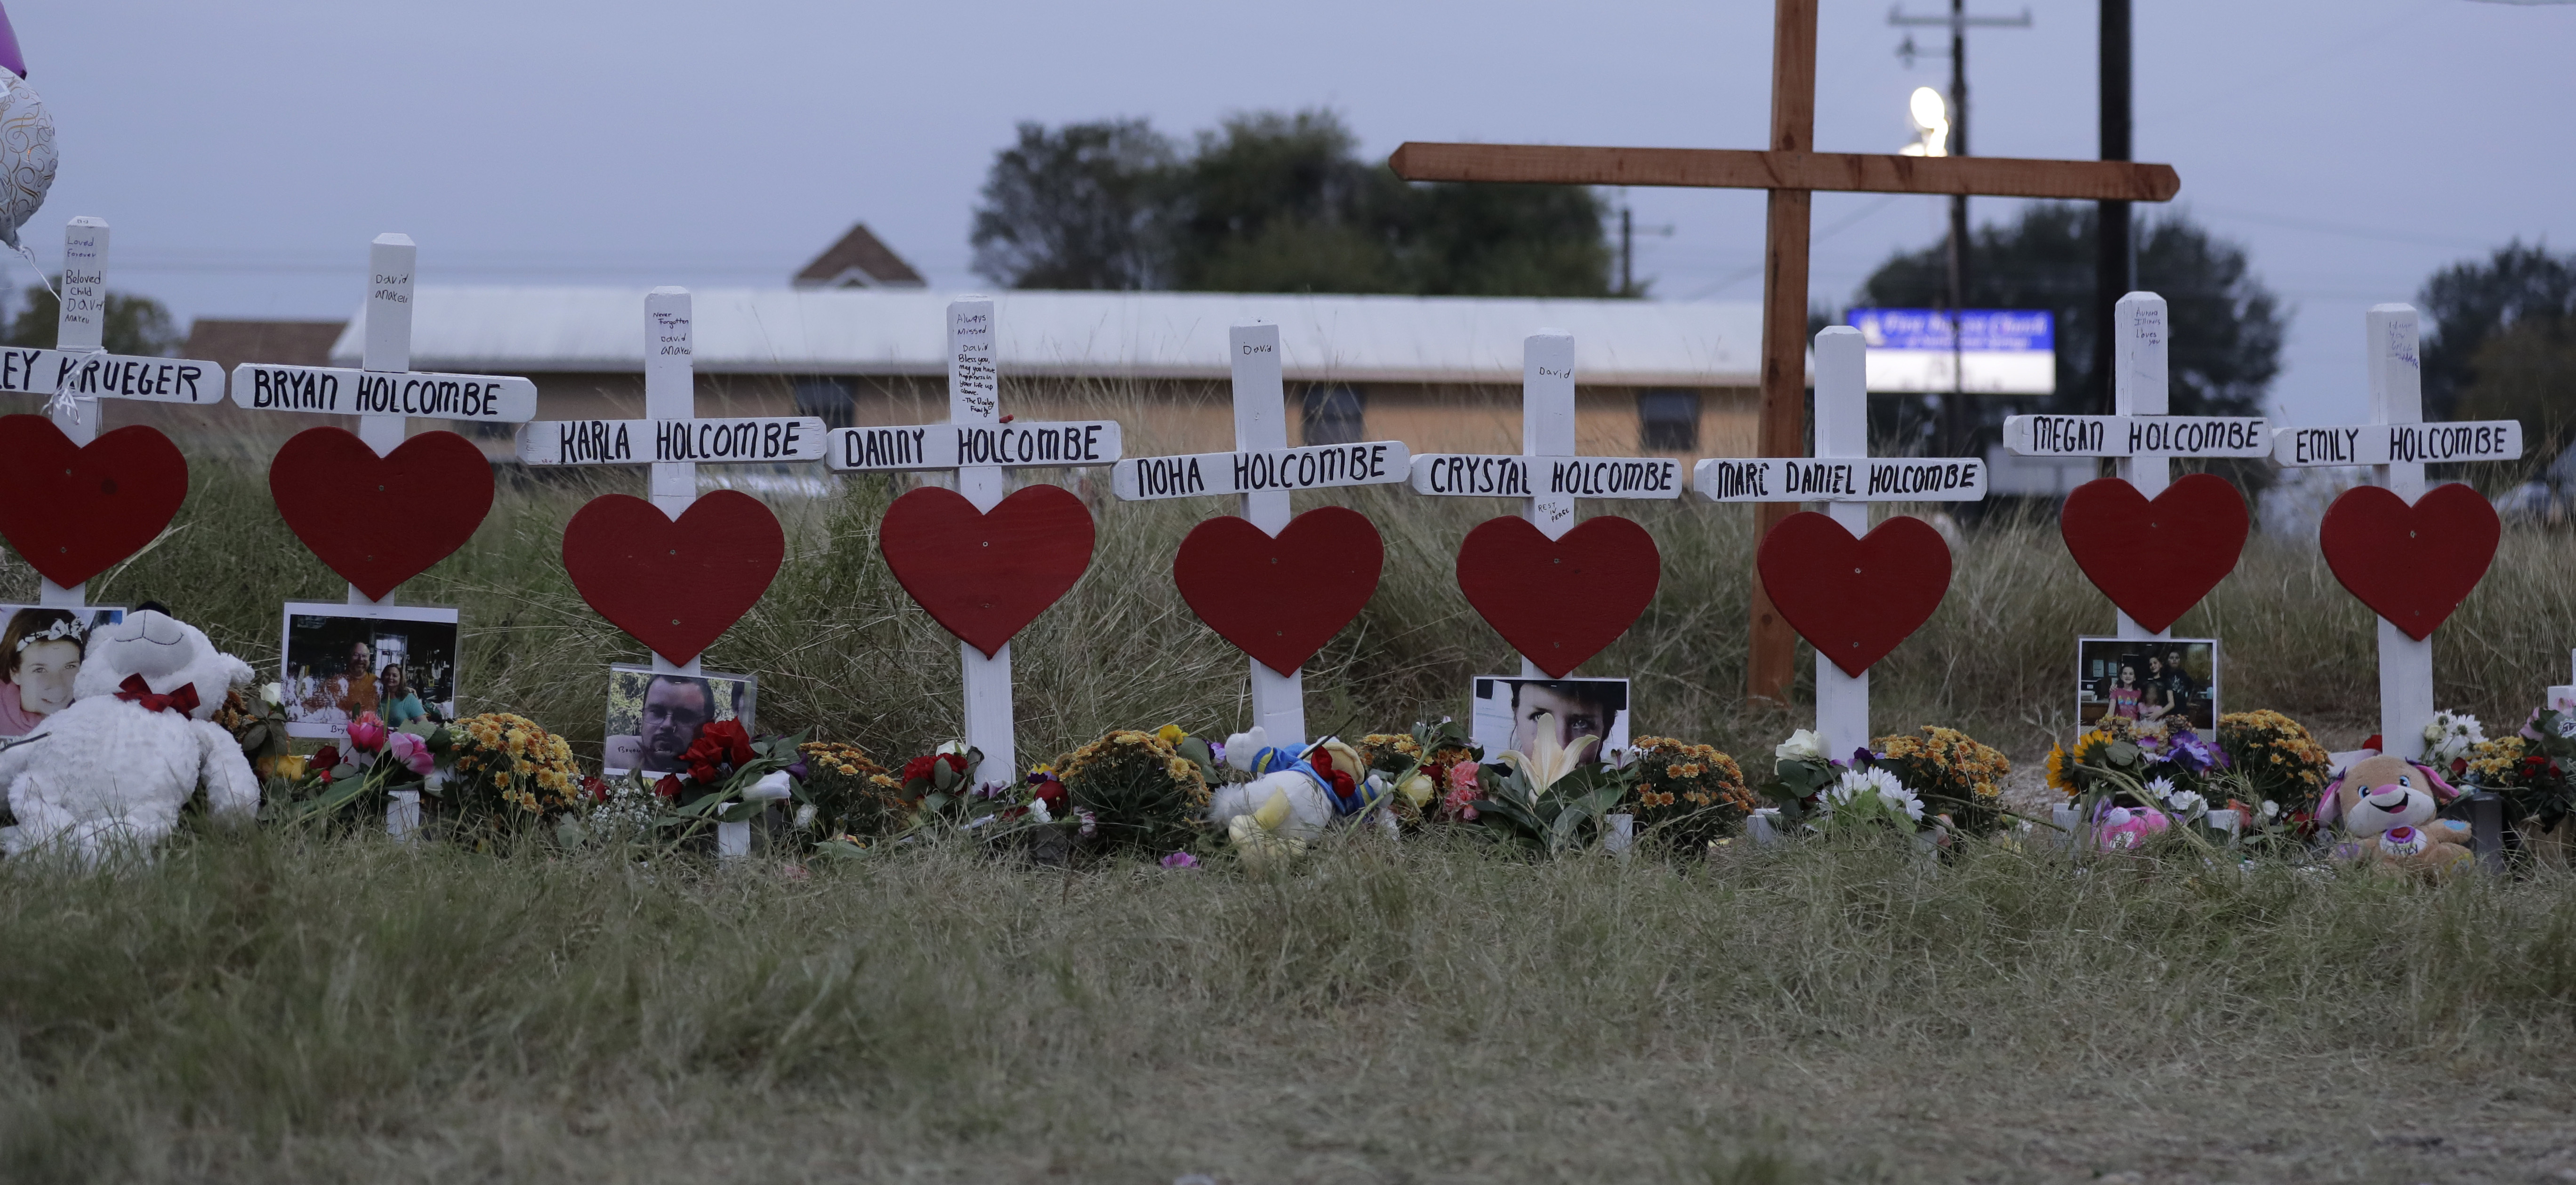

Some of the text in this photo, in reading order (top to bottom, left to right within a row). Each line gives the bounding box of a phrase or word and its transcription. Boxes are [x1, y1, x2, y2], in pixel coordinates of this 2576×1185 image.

[67, 236, 94, 247] Loved
[66, 269, 101, 284] Beloved
[376, 274, 409, 285] David
[71, 287, 92, 297] Child
[658, 318, 689, 329] Forgotten
[957, 313, 986, 324] Always
[958, 325, 987, 336] Missed
[2136, 329, 2157, 338] Loves
[661, 333, 686, 342] David
[963, 343, 988, 352] David
[1243, 342, 1272, 355] David
[958, 354, 990, 365] Bless you,
[0, 350, 201, 403] EY KRUEGER
[959, 371, 985, 381] happiness
[972, 366, 982, 376] you
[1539, 366, 1571, 379] David
[254, 369, 506, 416] BRYAN HOLCOMBE
[970, 406, 991, 418] Family
[2033, 416, 2263, 453] MEGAN HOLCOMBE
[561, 420, 800, 465] KARLA HOLCOMBE
[843, 425, 1104, 468] DANNY HOLCOMBE
[2296, 427, 2508, 464] EMILY HOLCOMBE
[1137, 444, 1389, 497] NOHA HOLCOMBE
[1431, 456, 1674, 495] CRYSTAL HOLCOMBE
[1717, 461, 1978, 500] MARC DANIEL HOLCOMBE
[1538, 502, 1555, 512] REST
